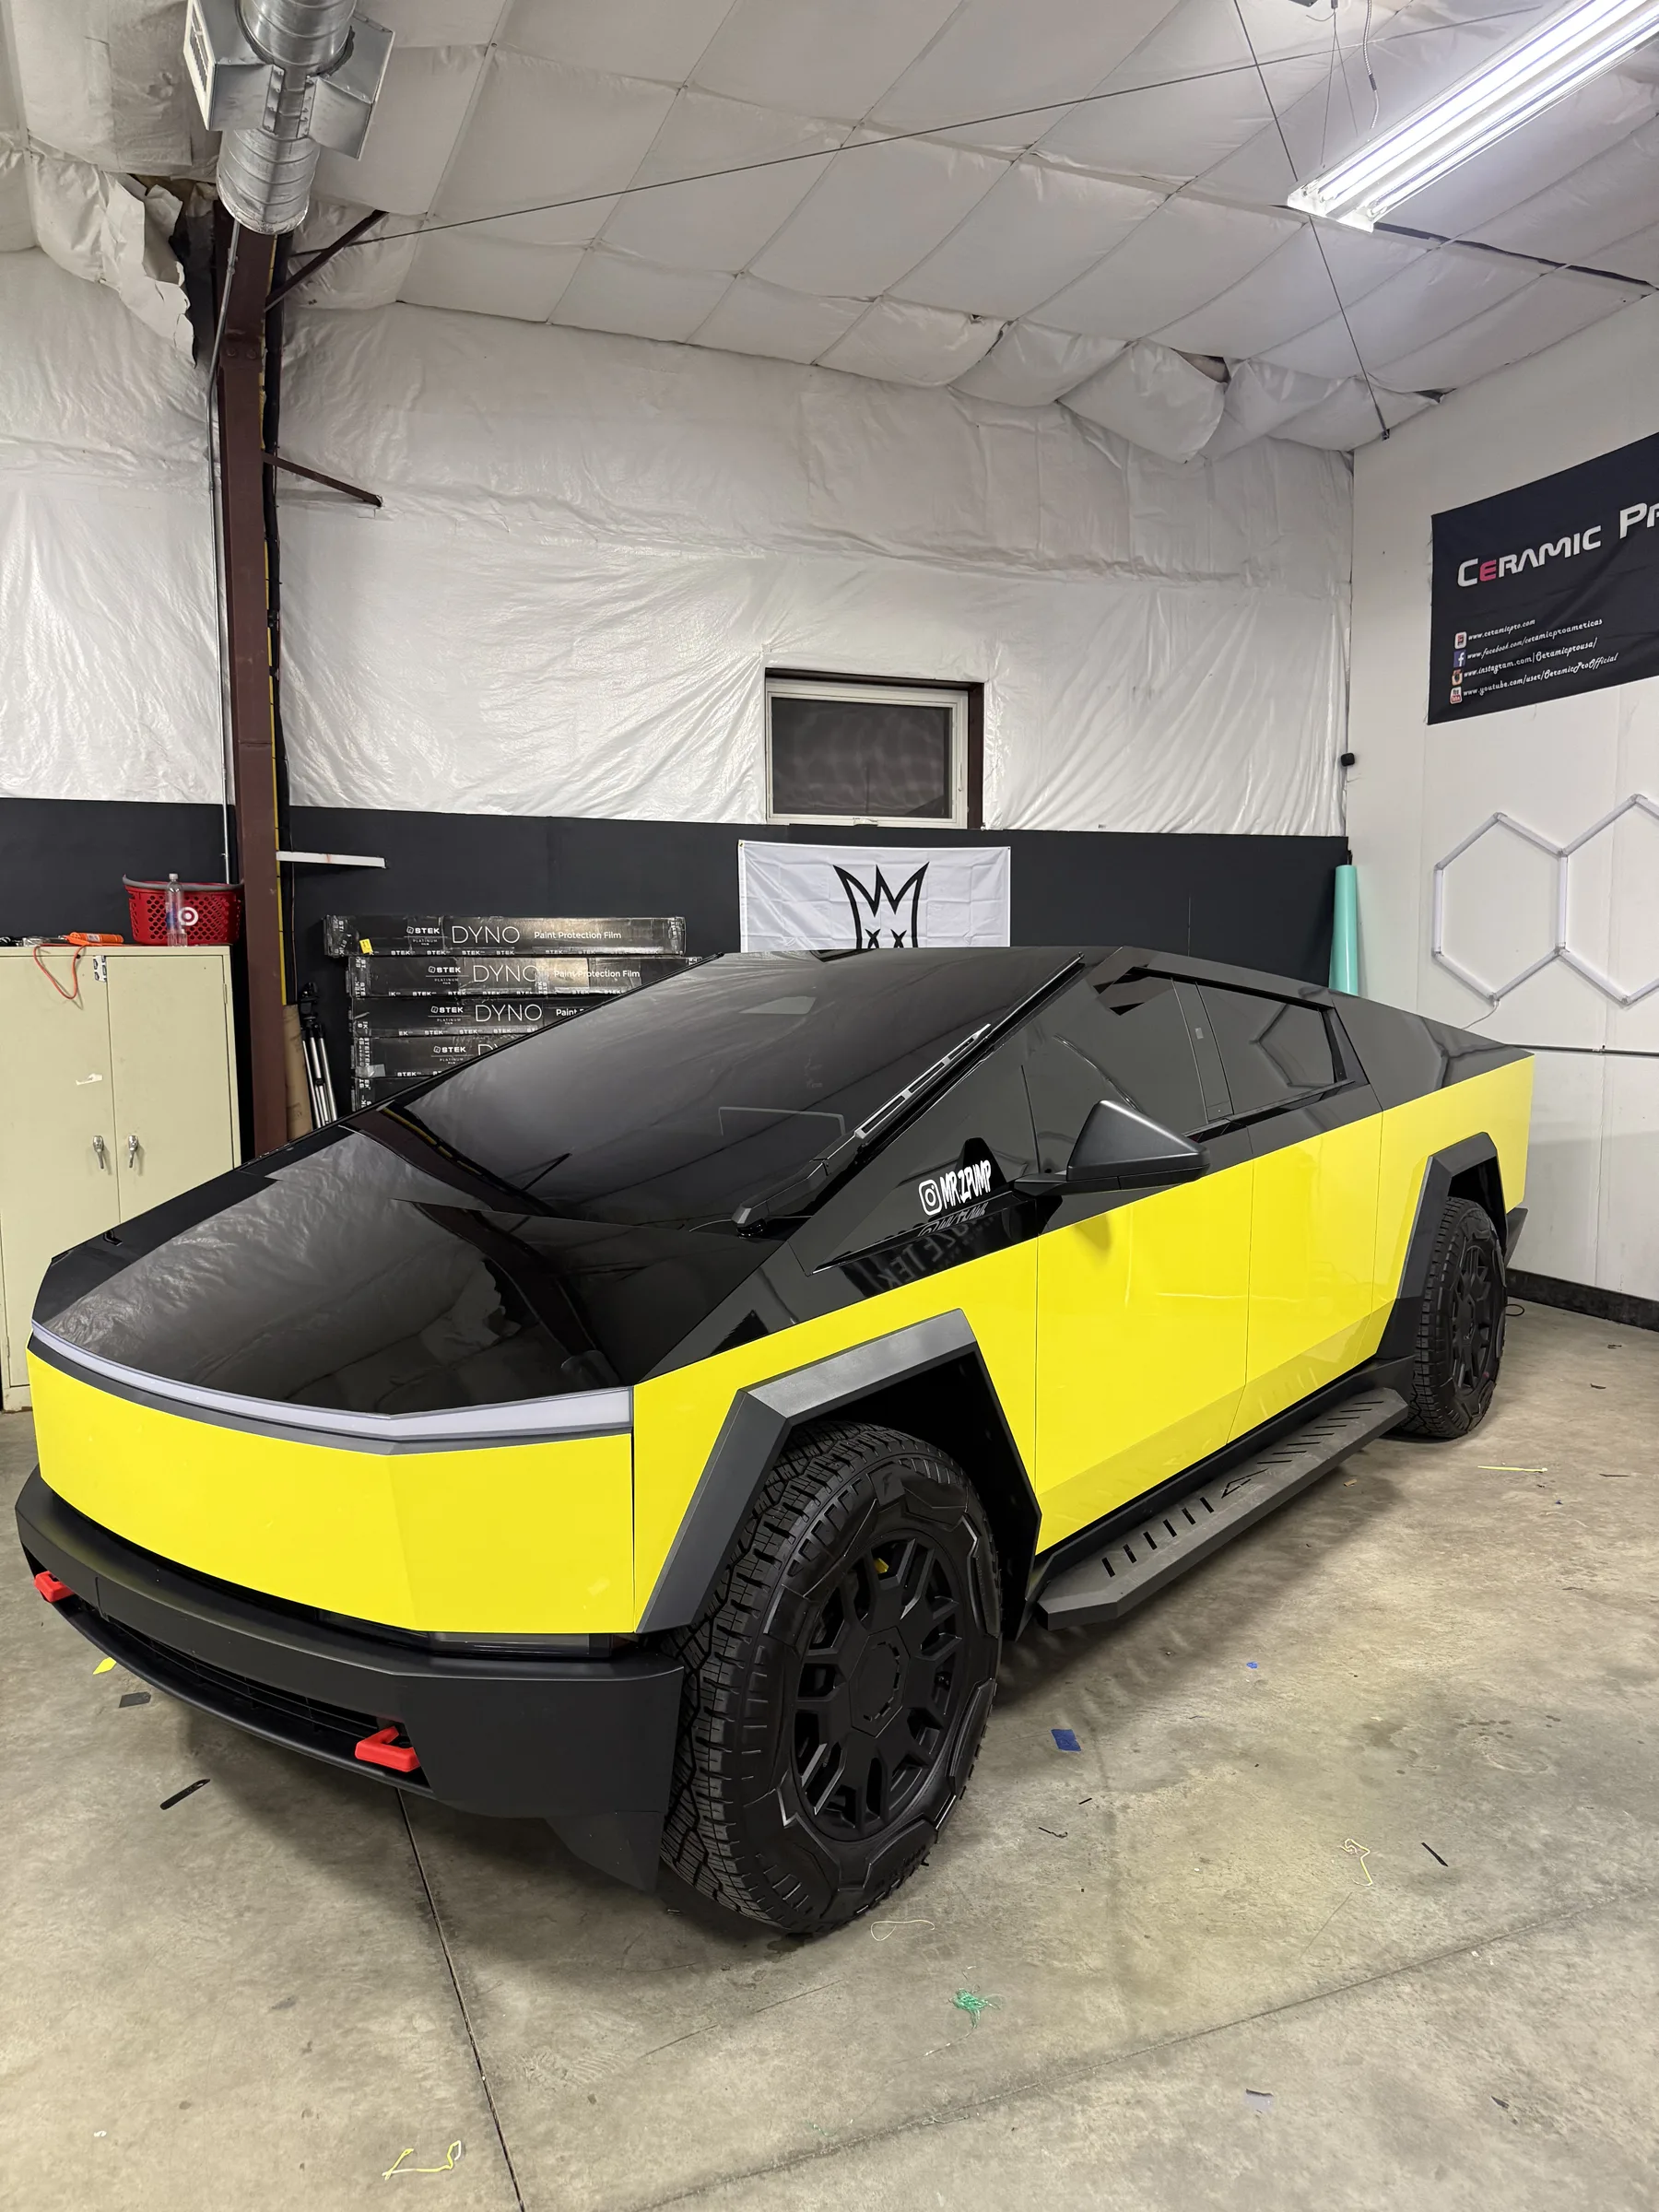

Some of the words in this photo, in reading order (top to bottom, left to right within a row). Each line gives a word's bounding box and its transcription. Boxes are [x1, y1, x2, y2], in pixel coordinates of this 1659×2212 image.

[1457, 525, 1601, 587] CERAMIC
[1468, 618, 1535, 641] www.ceramicpro.com
[452, 925, 520, 944] DYNO
[535, 931, 556, 939] Paint
[558, 931, 602, 939] Protection
[604, 931, 622, 939] Film
[473, 965, 539, 982] DYNO
[578, 970, 620, 978] Protection
[475, 1004, 542, 1022] DYNO
